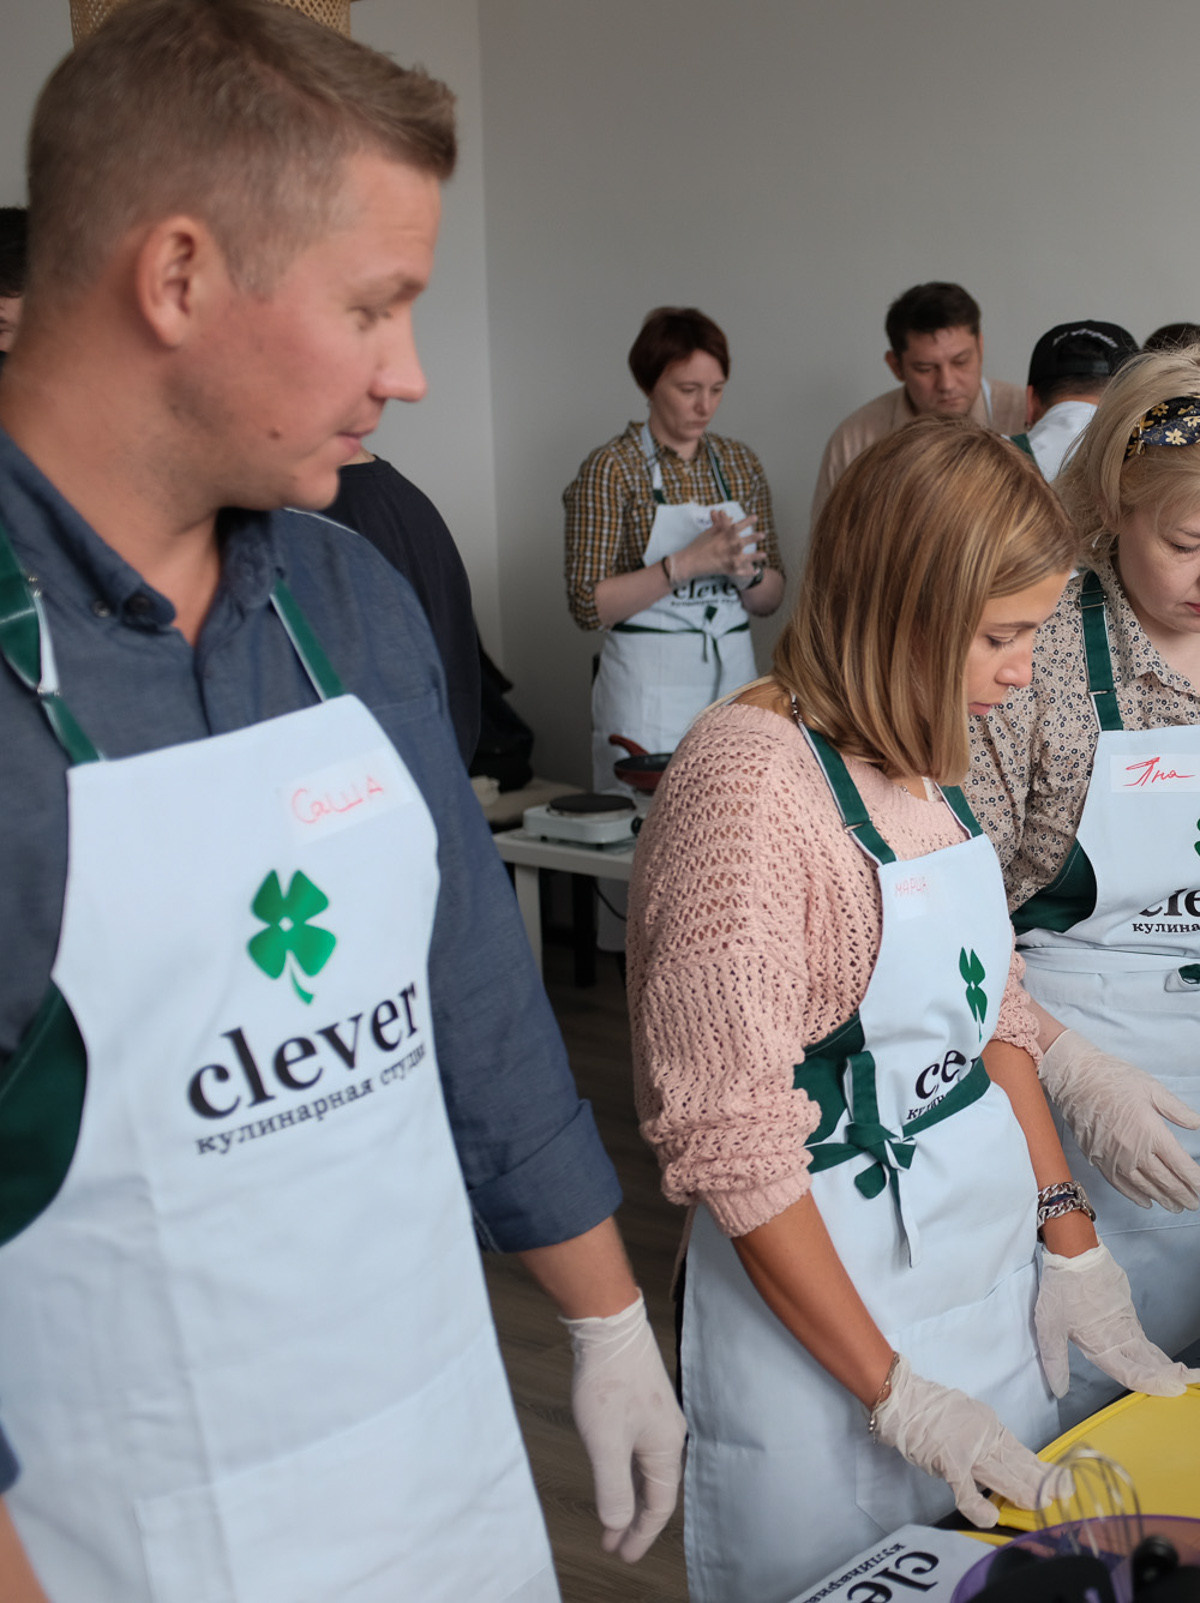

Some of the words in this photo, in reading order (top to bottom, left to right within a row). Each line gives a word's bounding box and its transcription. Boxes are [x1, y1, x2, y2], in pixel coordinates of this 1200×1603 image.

[1122, 756, 1196, 787] Яна
[187, 981, 418, 1121] clever
[195, 1078, 375, 1155] кулинарная
